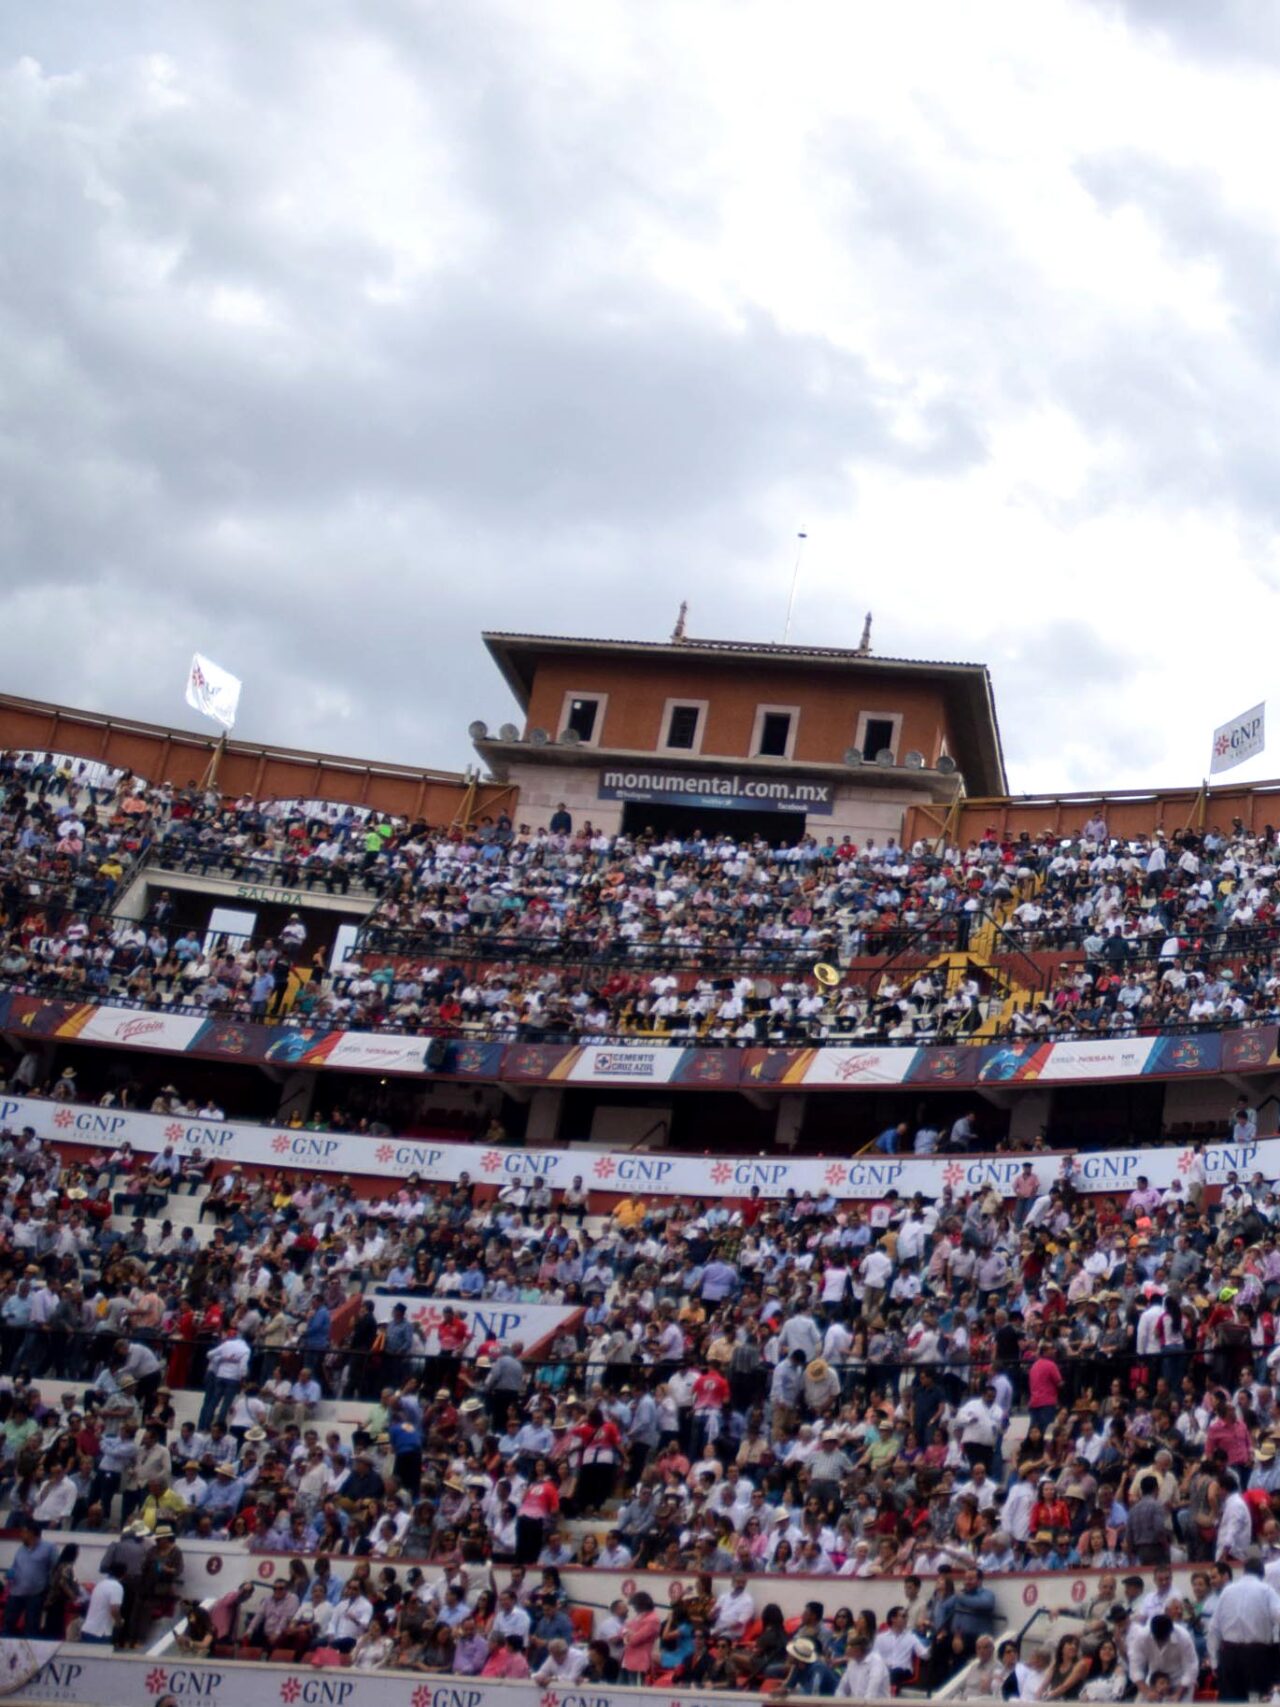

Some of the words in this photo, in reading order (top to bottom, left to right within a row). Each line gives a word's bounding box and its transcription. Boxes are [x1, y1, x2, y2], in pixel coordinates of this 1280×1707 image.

[1230, 718, 1261, 748] GNP
[603, 771, 829, 801] monumental.com.mx
[237, 885, 304, 905] SALIDA
[115, 1016, 165, 1041] Victoria
[611, 1063, 633, 1071] CRUZ
[634, 1063, 654, 1071] AZUL
[612, 1053, 655, 1062] CEMENTO
[76, 1113, 126, 1133] GNP
[186, 1127, 233, 1146] GNP
[291, 1138, 338, 1156] GNP
[396, 1147, 441, 1166] GNP
[504, 1153, 559, 1175] GNP
[1084, 1156, 1138, 1178] GNP
[1203, 1147, 1257, 1171] GNP
[618, 1160, 672, 1180] GNP
[735, 1165, 788, 1184] GNP
[849, 1165, 902, 1185] GNP
[967, 1164, 1020, 1184] GNP
[471, 1312, 521, 1338] NP
[169, 1670, 222, 1695] GNP
[303, 1680, 353, 1705] GNP
[433, 1688, 482, 1707] GNP
